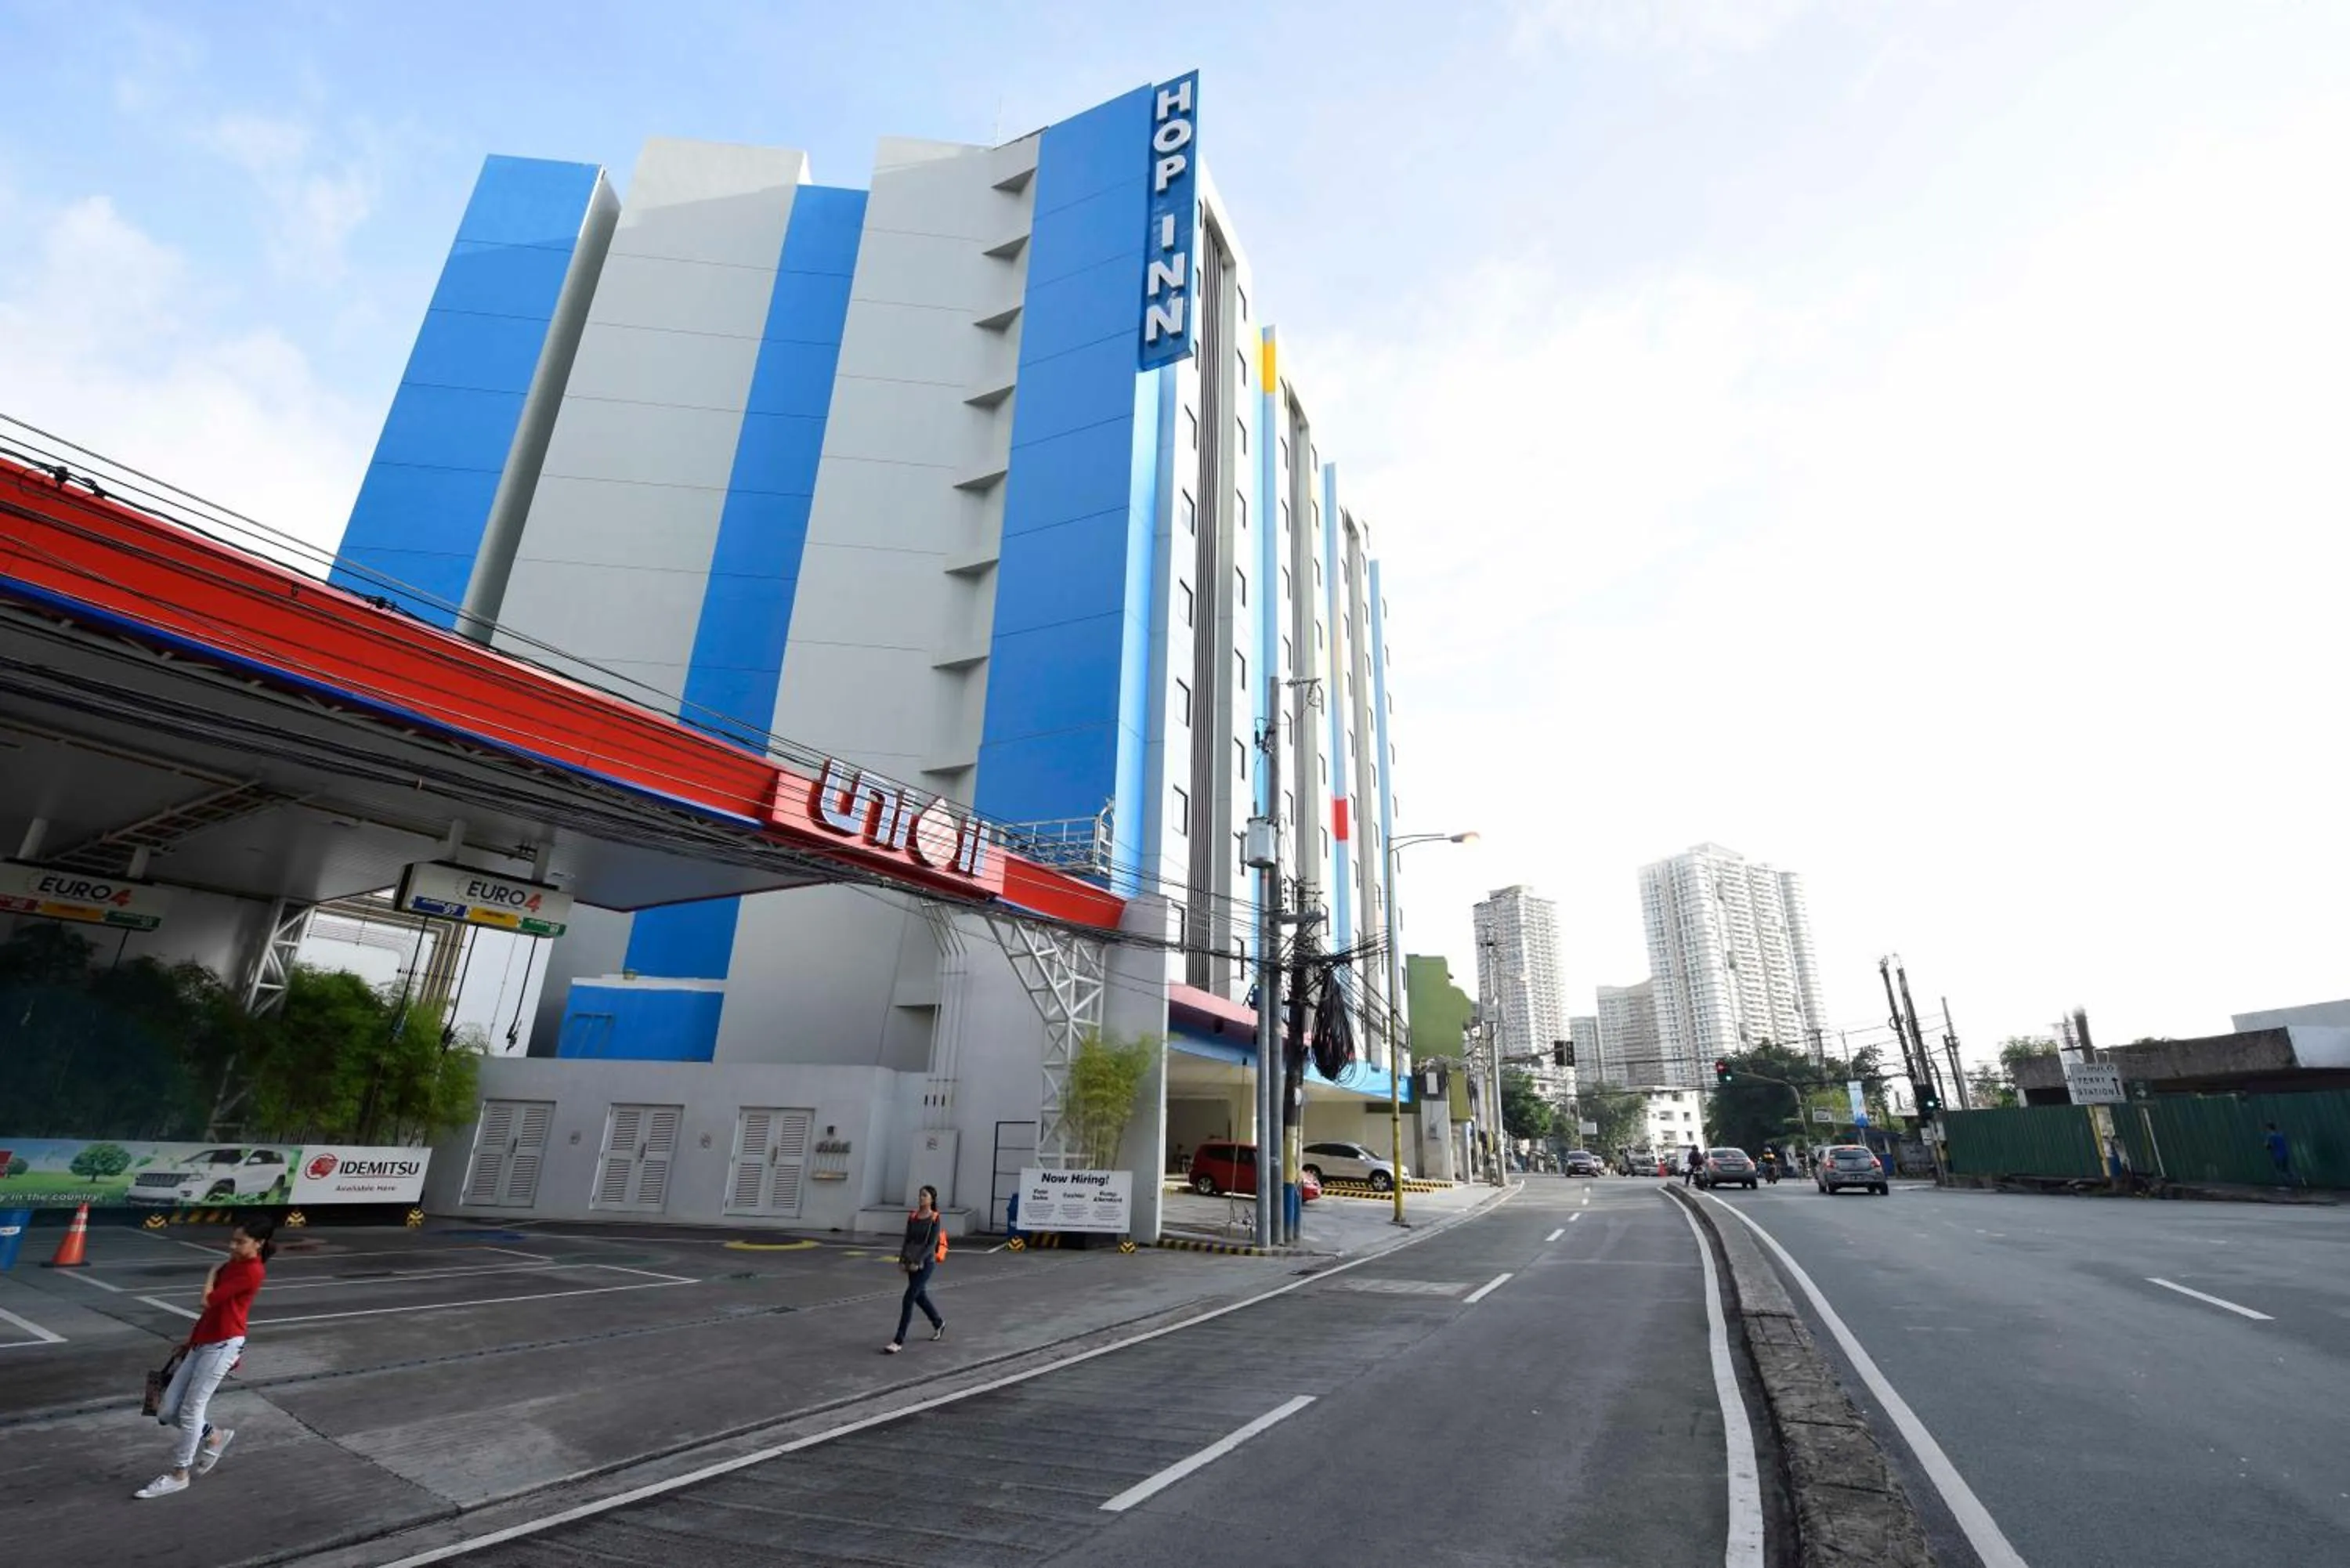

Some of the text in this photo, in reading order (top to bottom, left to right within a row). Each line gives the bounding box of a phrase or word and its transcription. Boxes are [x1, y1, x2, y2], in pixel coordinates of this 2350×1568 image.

[1145, 80, 1192, 343] HOP INN
[338, 1161, 421, 1175] IDEMITSU
[1041, 1173, 1110, 1187] Now Hiring!
